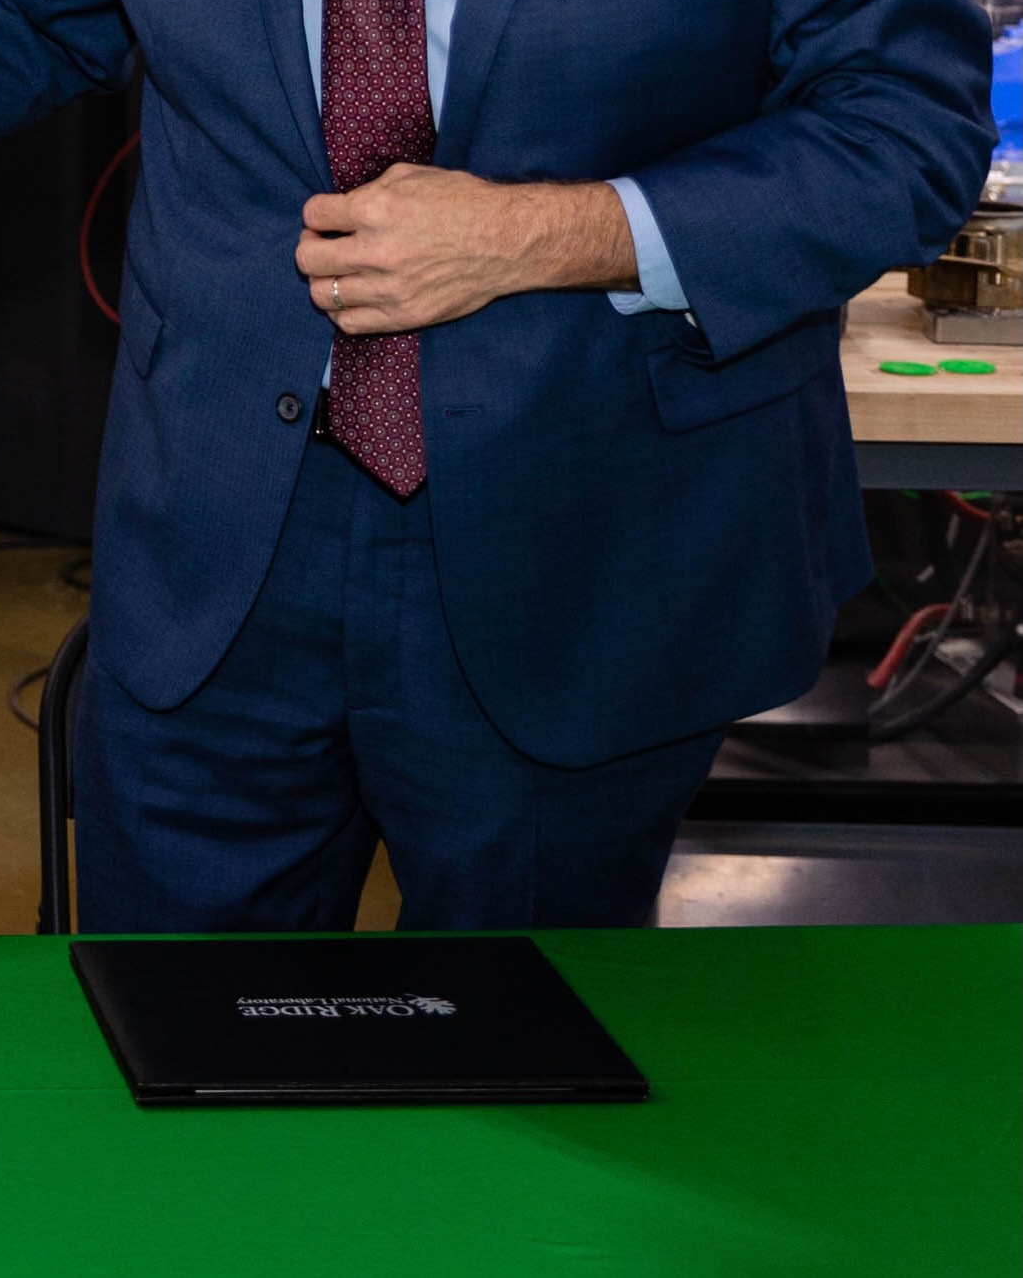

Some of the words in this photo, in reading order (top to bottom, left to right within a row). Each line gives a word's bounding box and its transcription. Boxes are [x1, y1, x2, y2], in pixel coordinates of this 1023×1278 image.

[236, 996, 328, 1005] Laboratory
[332, 996, 404, 1004] National
[239, 1005, 342, 1017] RIDGE
[344, 1004, 414, 1017] OAK
